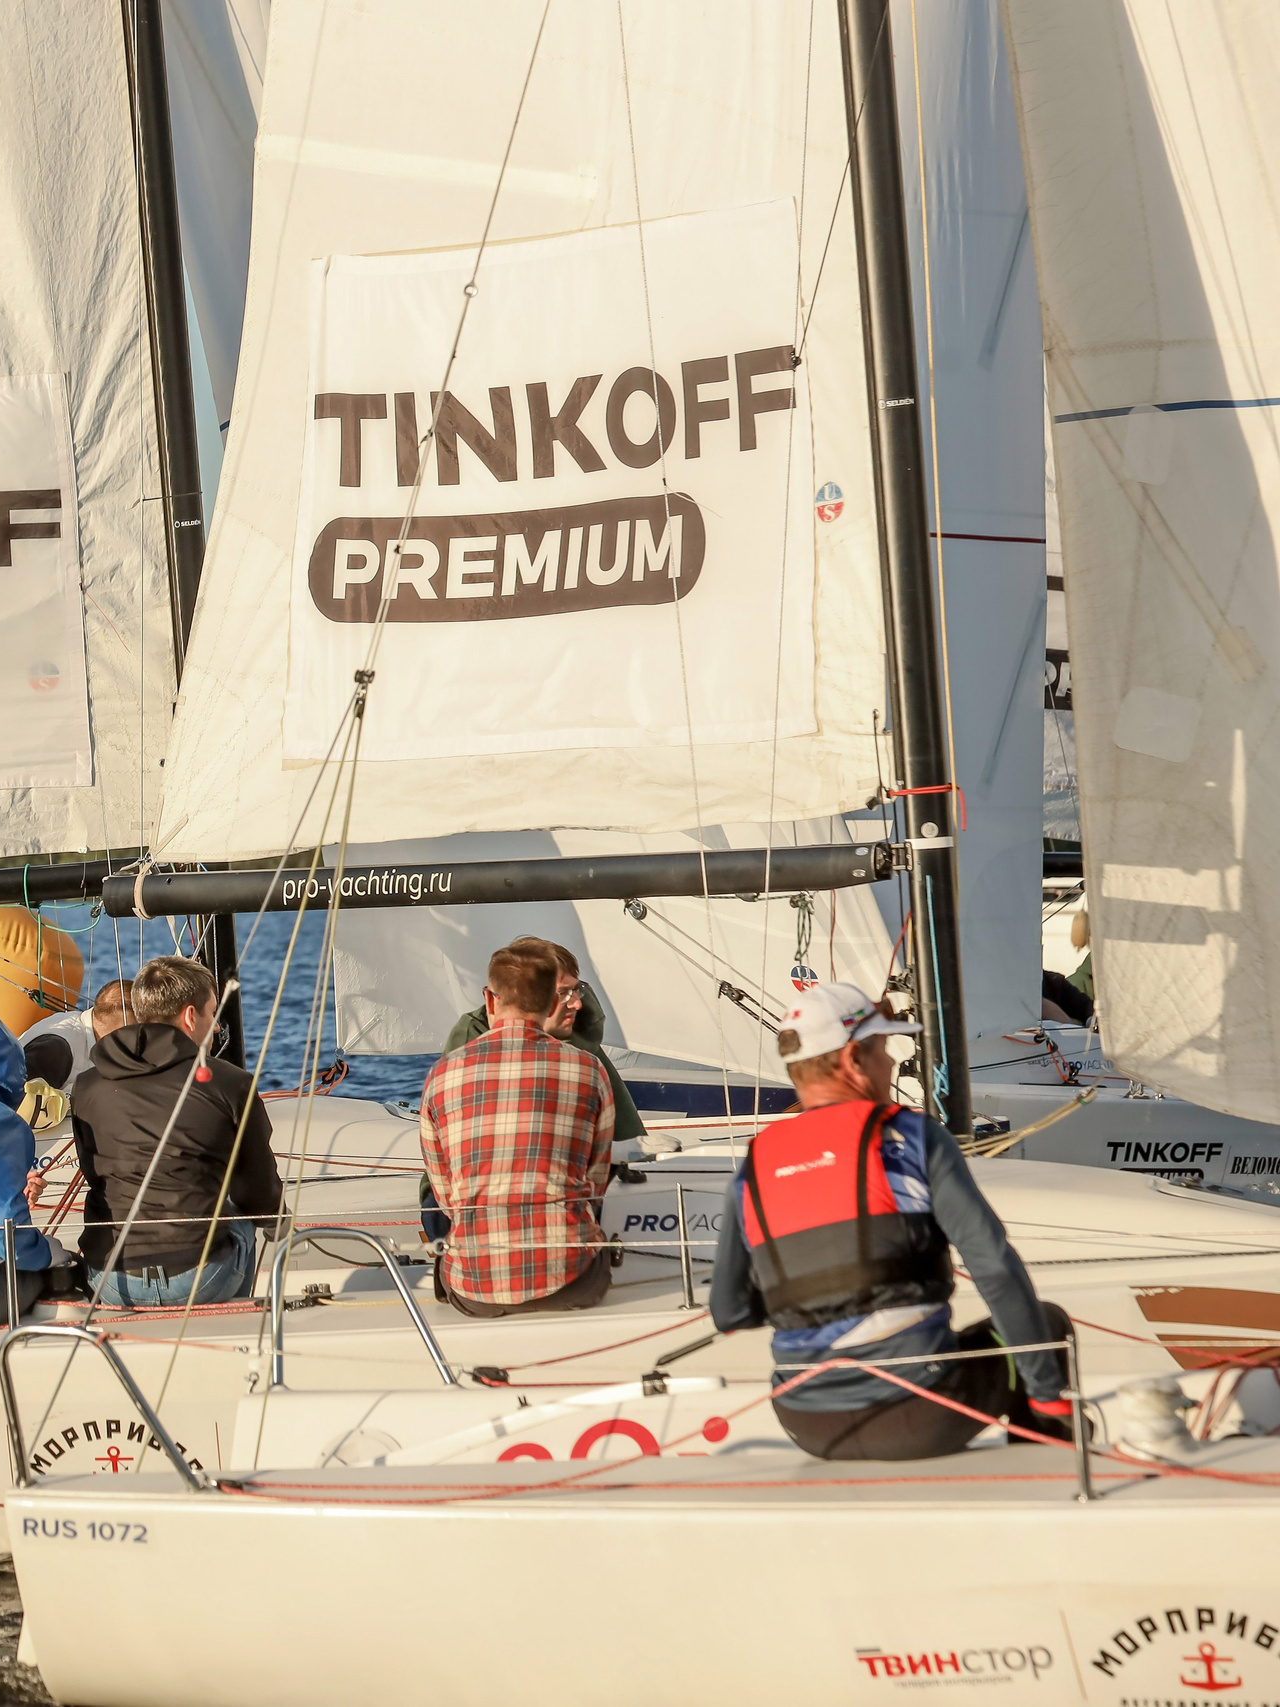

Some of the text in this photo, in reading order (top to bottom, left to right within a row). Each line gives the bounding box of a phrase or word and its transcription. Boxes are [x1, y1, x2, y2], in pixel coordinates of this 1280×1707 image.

[314, 345, 796, 487] TINKOFF
[331, 514, 683, 600] PREMIUM
[282, 869, 453, 905] pro-yachting.ru
[1107, 1141, 1224, 1163] TINKOFF
[23, 1518, 148, 1544] RUS 1072
[1092, 1607, 1280, 1678] МОРПРИБ
